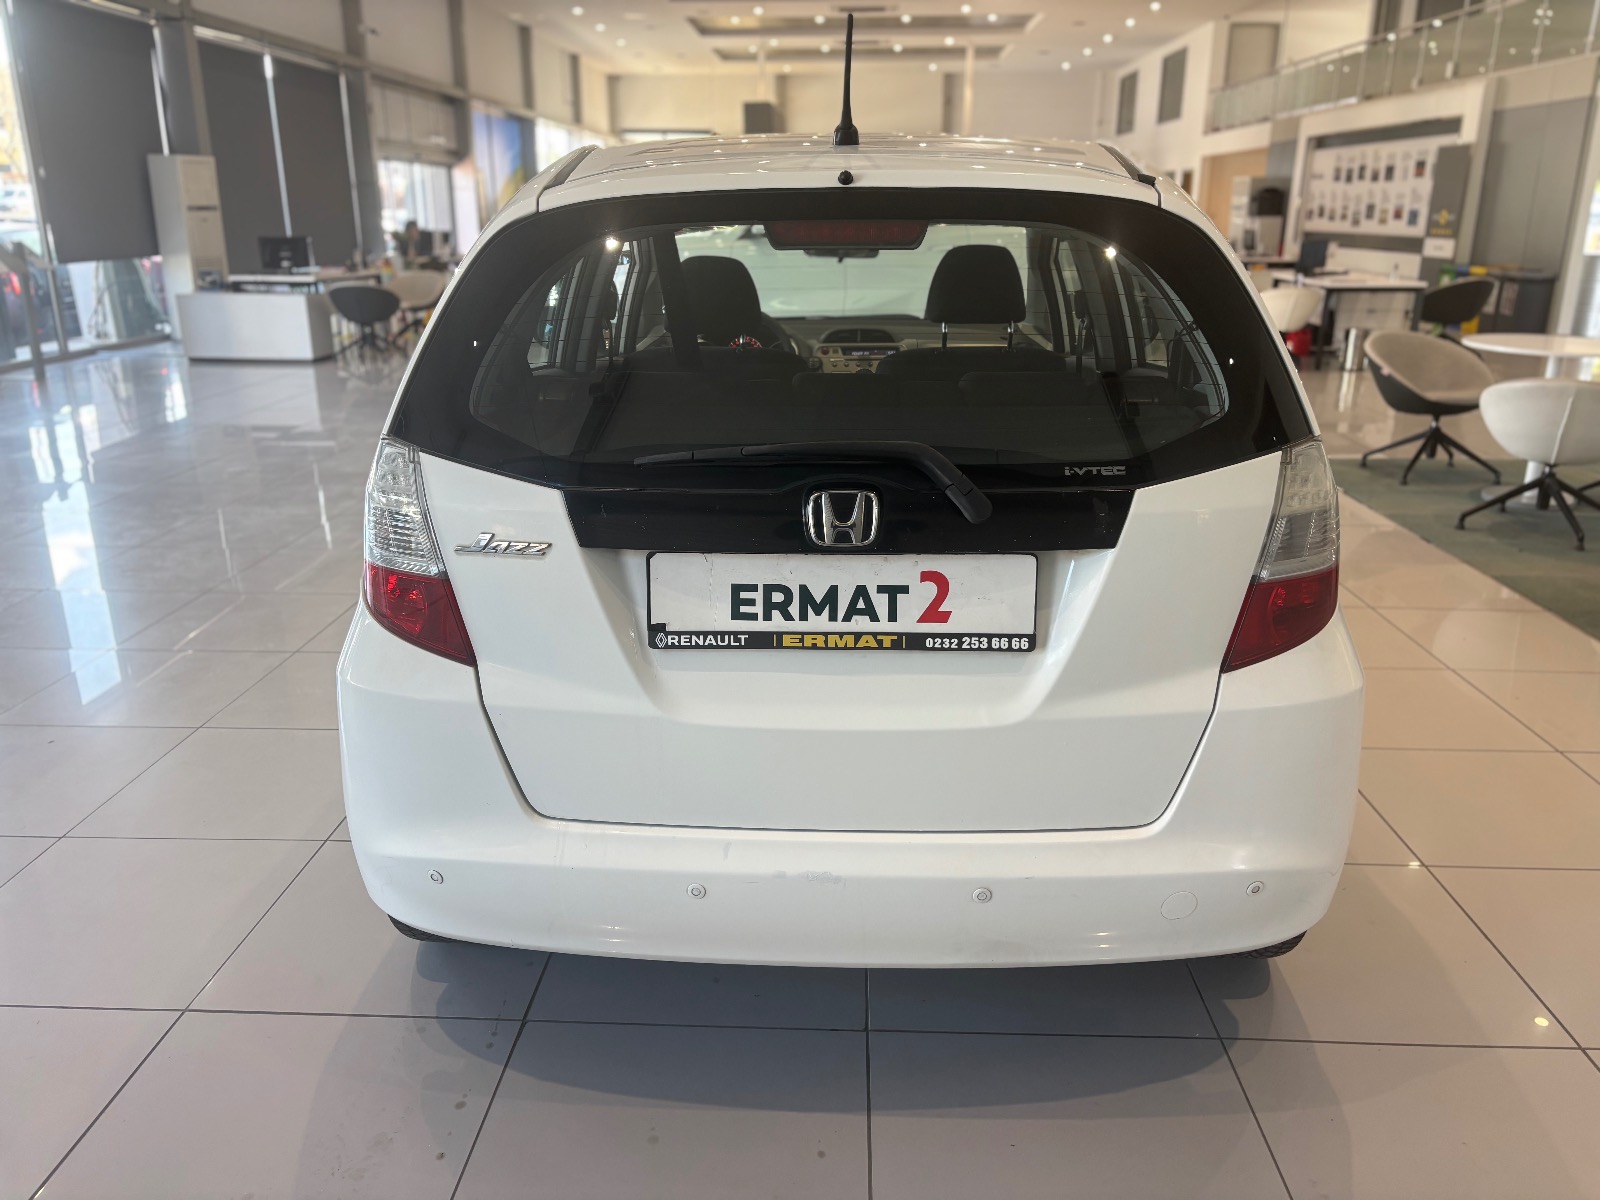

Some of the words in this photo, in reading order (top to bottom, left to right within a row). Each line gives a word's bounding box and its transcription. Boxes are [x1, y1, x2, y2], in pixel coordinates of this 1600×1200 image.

[1064, 465, 1126, 476] i-VTEC
[454, 532, 552, 555] Jazz
[731, 583, 909, 622] ERMAT
[916, 570, 953, 623] 2
[667, 635, 749, 646] RENAULT
[782, 634, 898, 647] ERMAT
[925, 638, 958, 648] 0232
[961, 637, 988, 648] 253
[991, 637, 1009, 649] 66
[1011, 638, 1029, 649] 66
